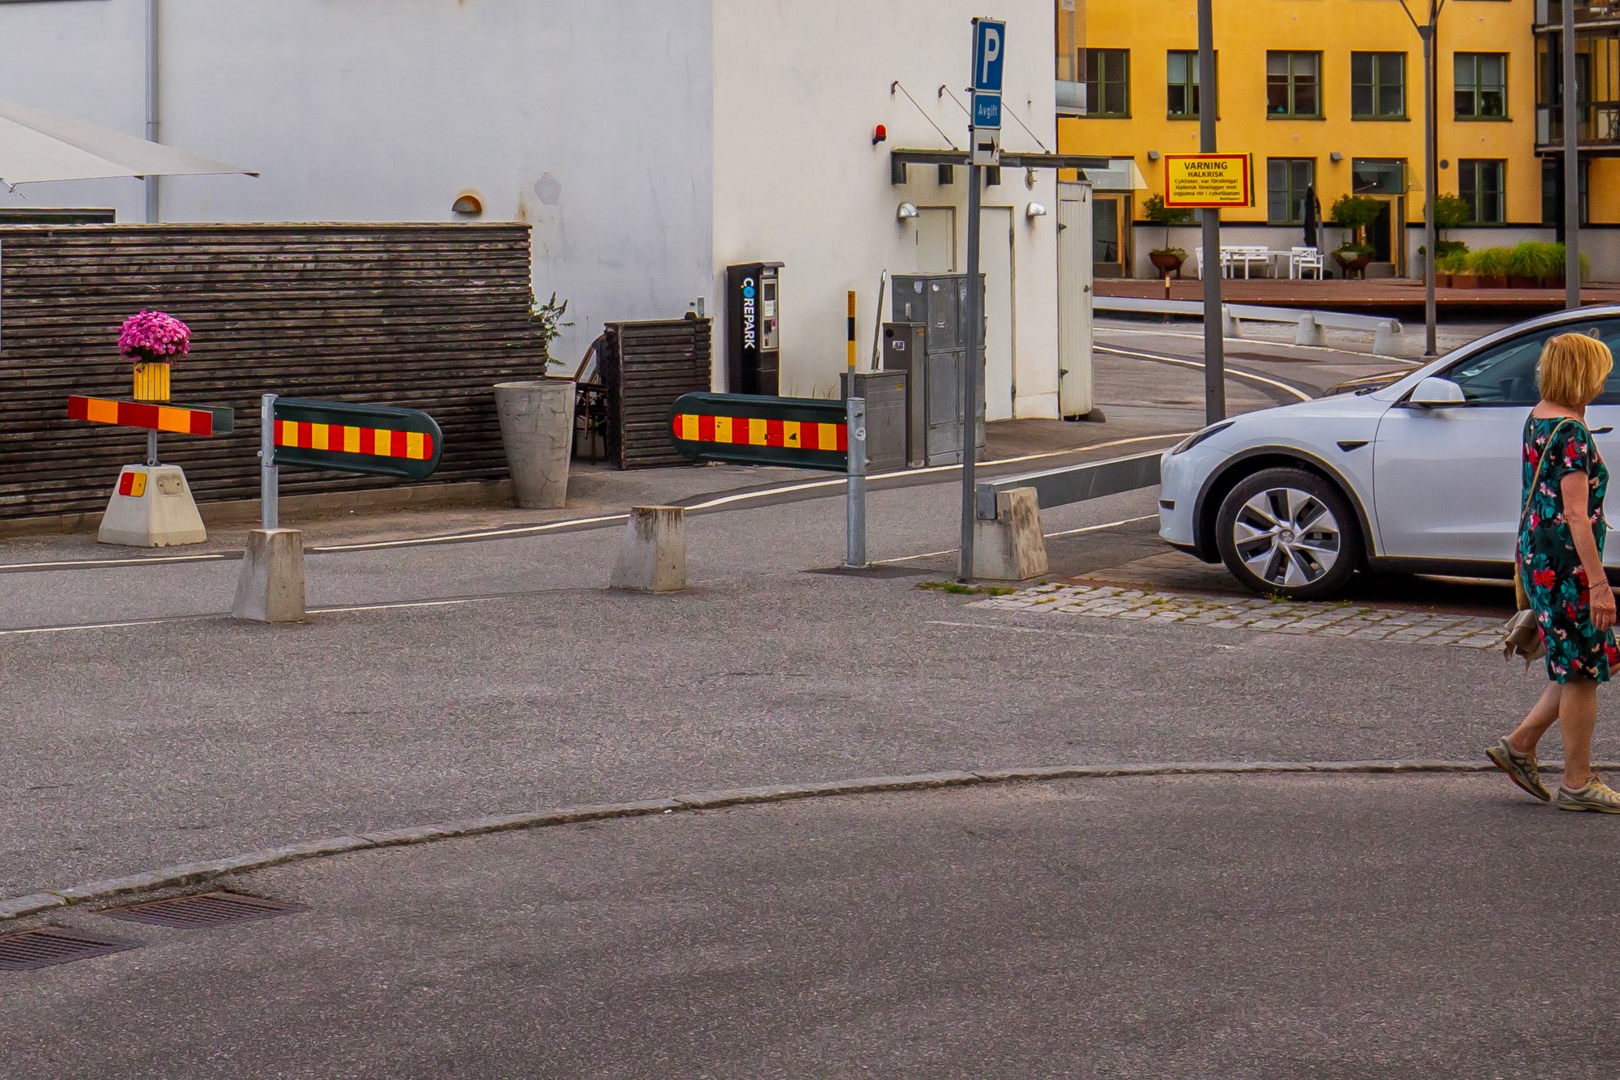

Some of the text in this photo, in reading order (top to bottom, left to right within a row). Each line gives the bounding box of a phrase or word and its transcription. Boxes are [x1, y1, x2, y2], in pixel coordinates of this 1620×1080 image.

[982, 27, 1000, 84] P
[978, 103, 998, 120] Avgift
[1184, 161, 1227, 170] VARNING
[743, 277, 756, 350] COREPARK
